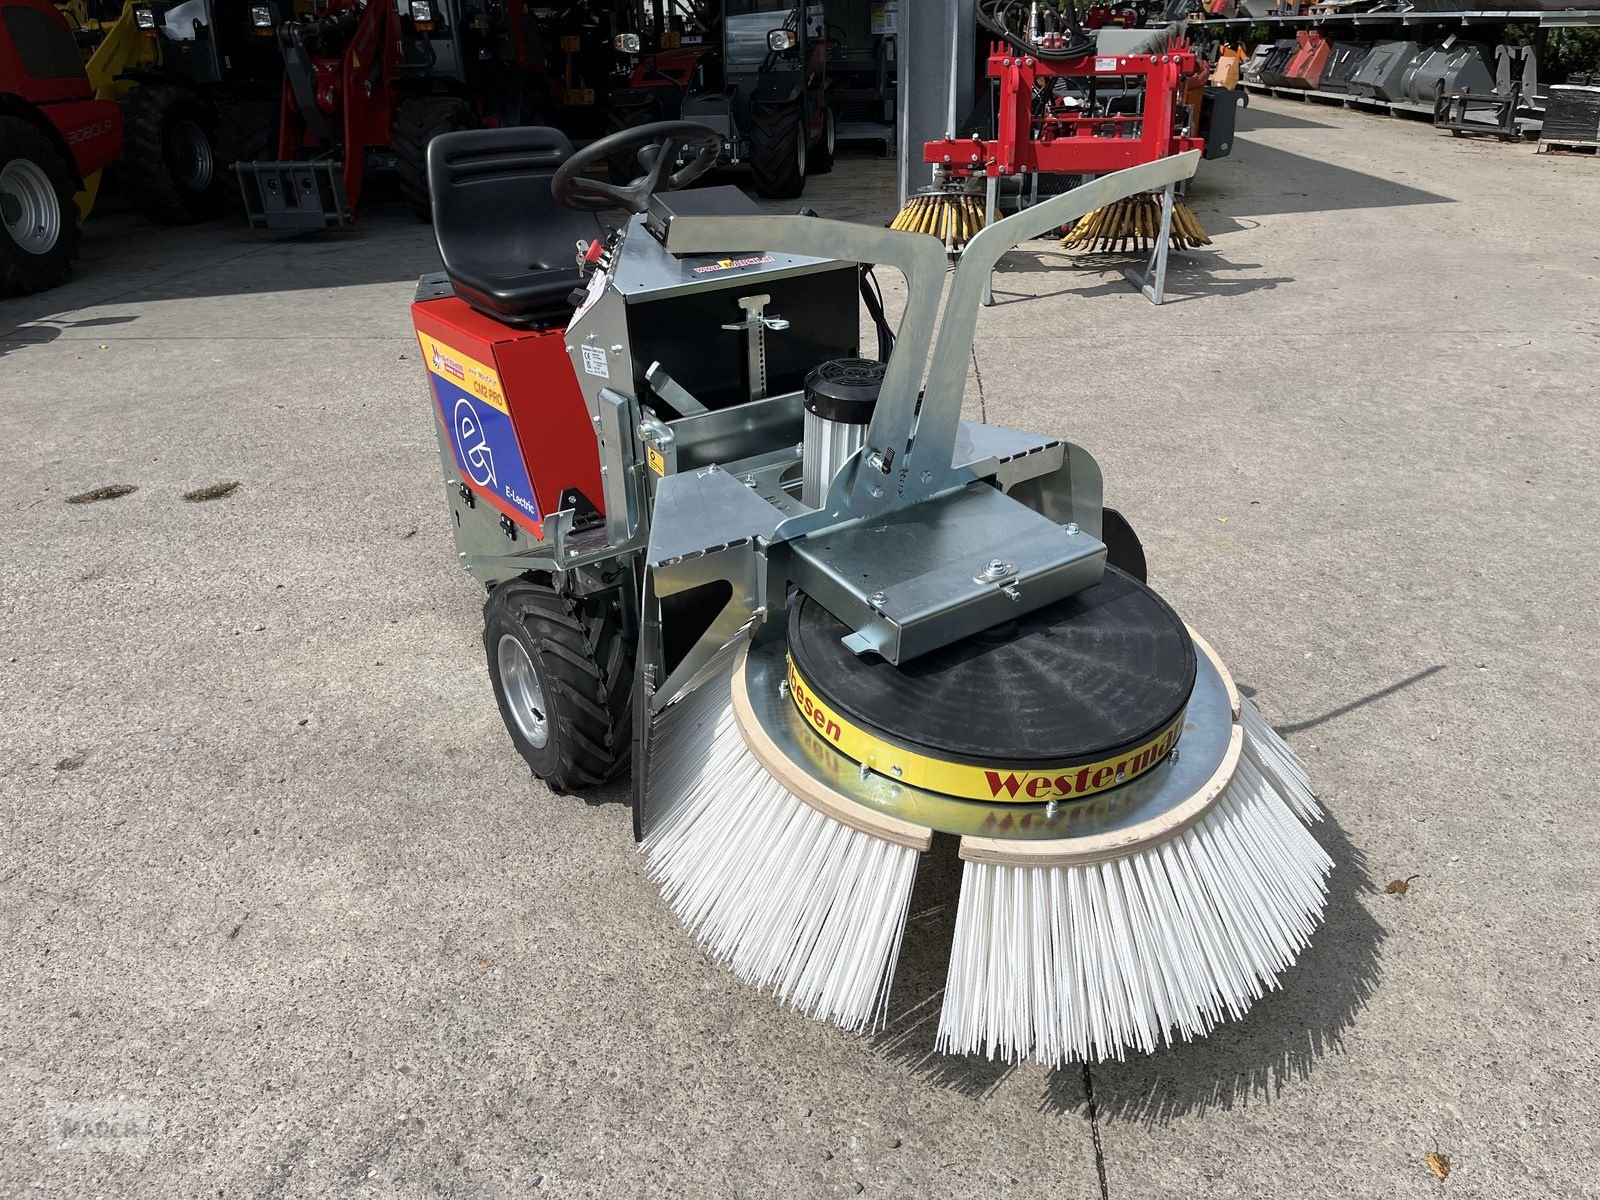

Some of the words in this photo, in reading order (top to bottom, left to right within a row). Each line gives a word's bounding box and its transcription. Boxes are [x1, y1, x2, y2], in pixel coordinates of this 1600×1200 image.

[473, 381, 488, 398] CM2
[488, 388, 503, 406] PRO
[504, 485, 535, 515] E-Lectric
